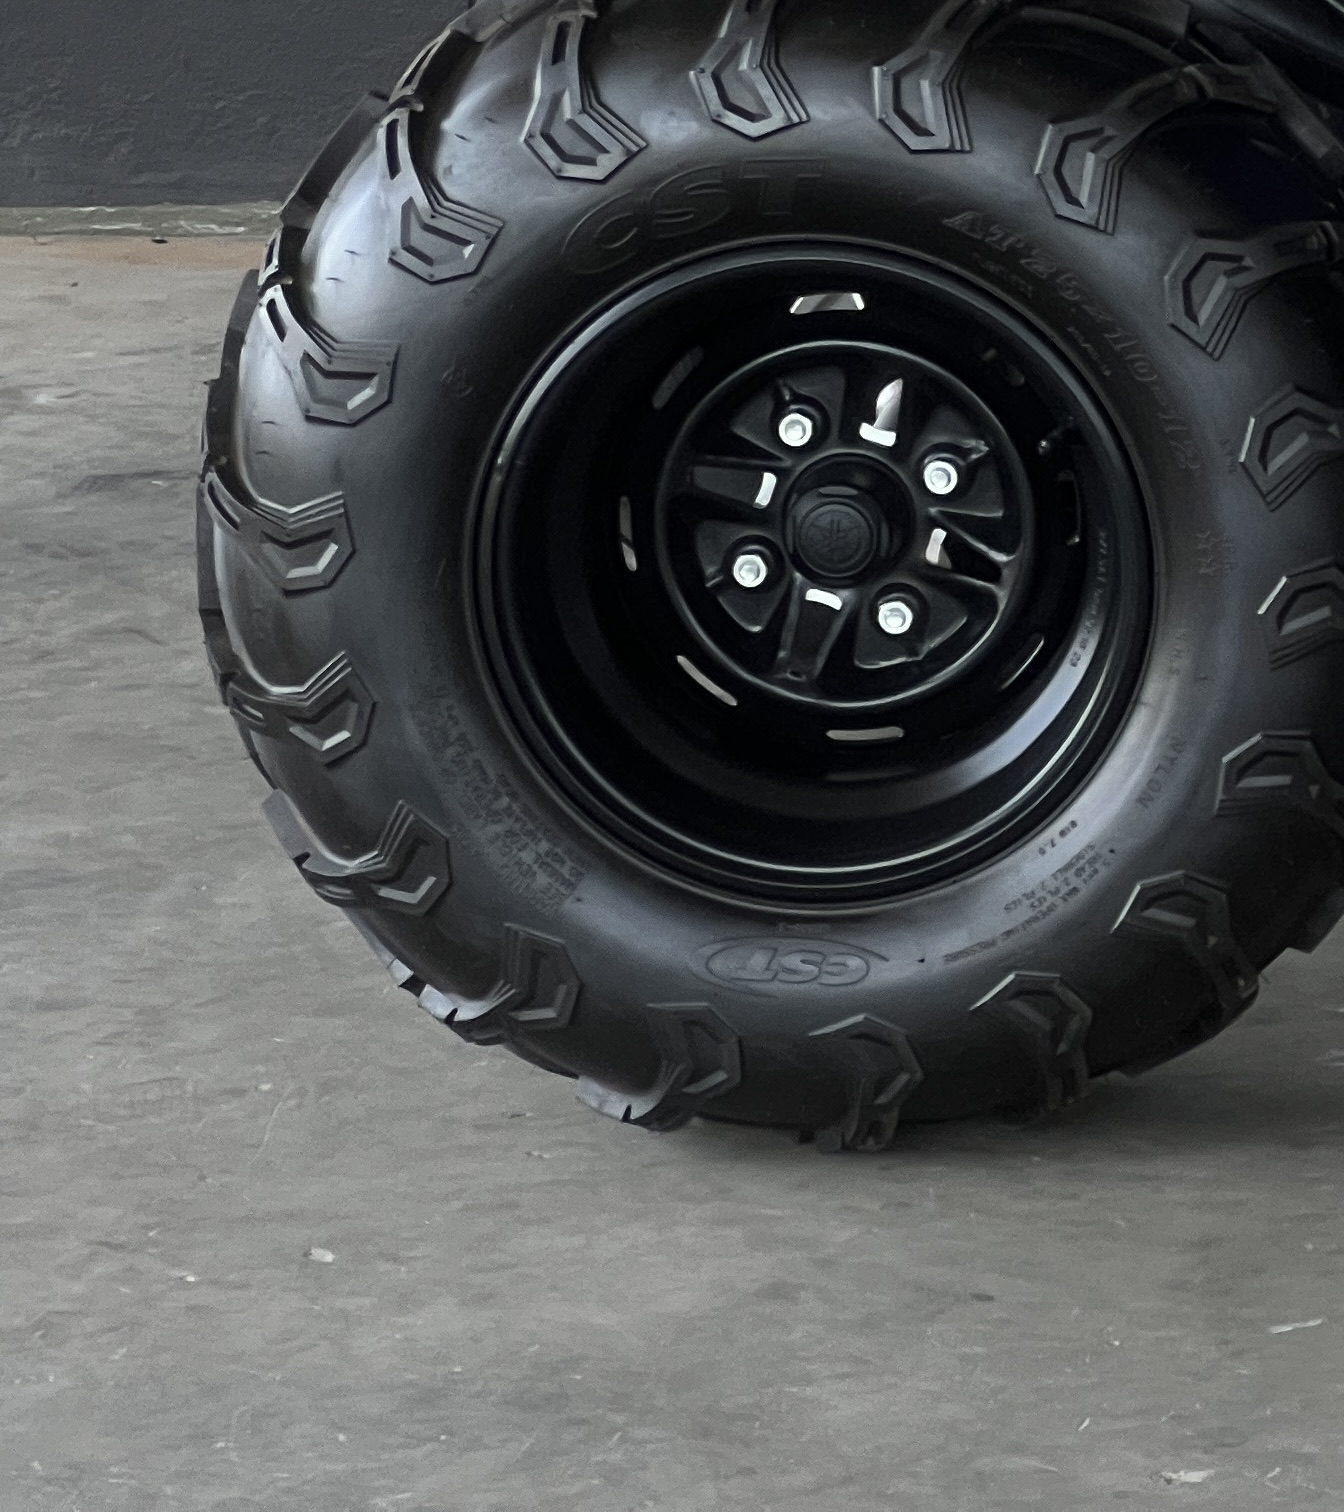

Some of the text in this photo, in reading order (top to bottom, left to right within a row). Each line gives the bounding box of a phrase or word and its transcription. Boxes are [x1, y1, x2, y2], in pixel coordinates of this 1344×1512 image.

[562, 156, 828, 276] CST
[1134, 735, 1187, 810] NYLON
[727, 946, 871, 987] CST
